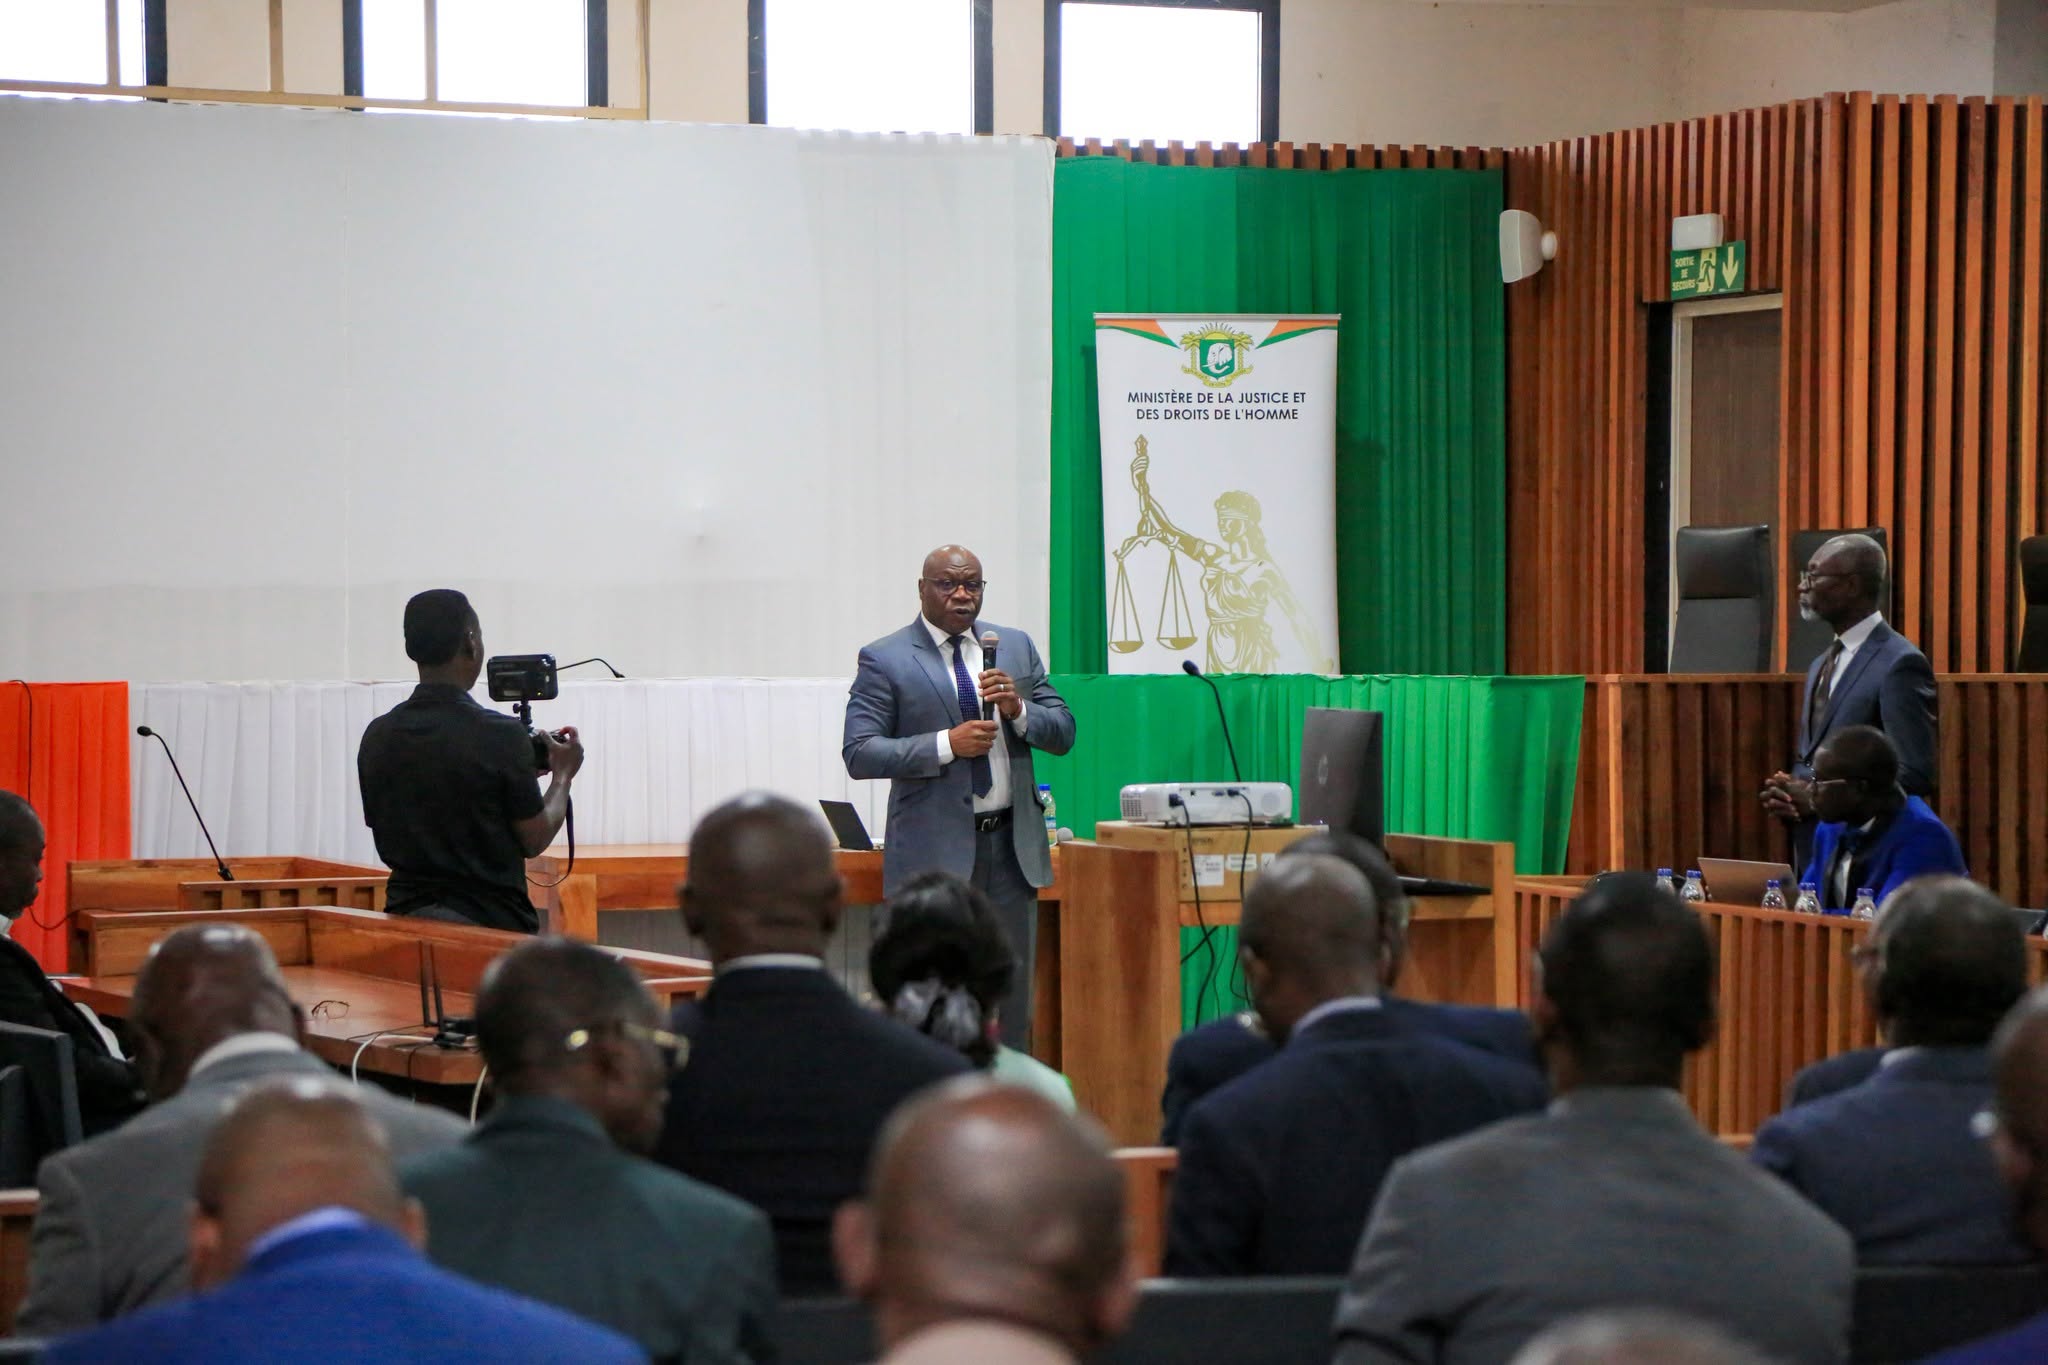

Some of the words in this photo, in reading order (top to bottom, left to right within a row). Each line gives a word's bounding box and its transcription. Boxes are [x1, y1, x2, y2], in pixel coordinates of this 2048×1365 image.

[1675, 256, 1694, 267] SORTIE
[1681, 268, 1688, 278] DE
[1672, 279, 1695, 291] SECOURS
[1127, 389, 1193, 404] MINISTÈRE
[1197, 392, 1214, 404] DE
[1218, 392, 1234, 404] LA
[1238, 392, 1289, 404] JUSTICE
[1293, 392, 1306, 403] ET
[1136, 409, 1160, 420] DES
[1164, 409, 1210, 420] DROITS
[1214, 409, 1231, 420] DE
[1235, 409, 1298, 420] L'HOMME
